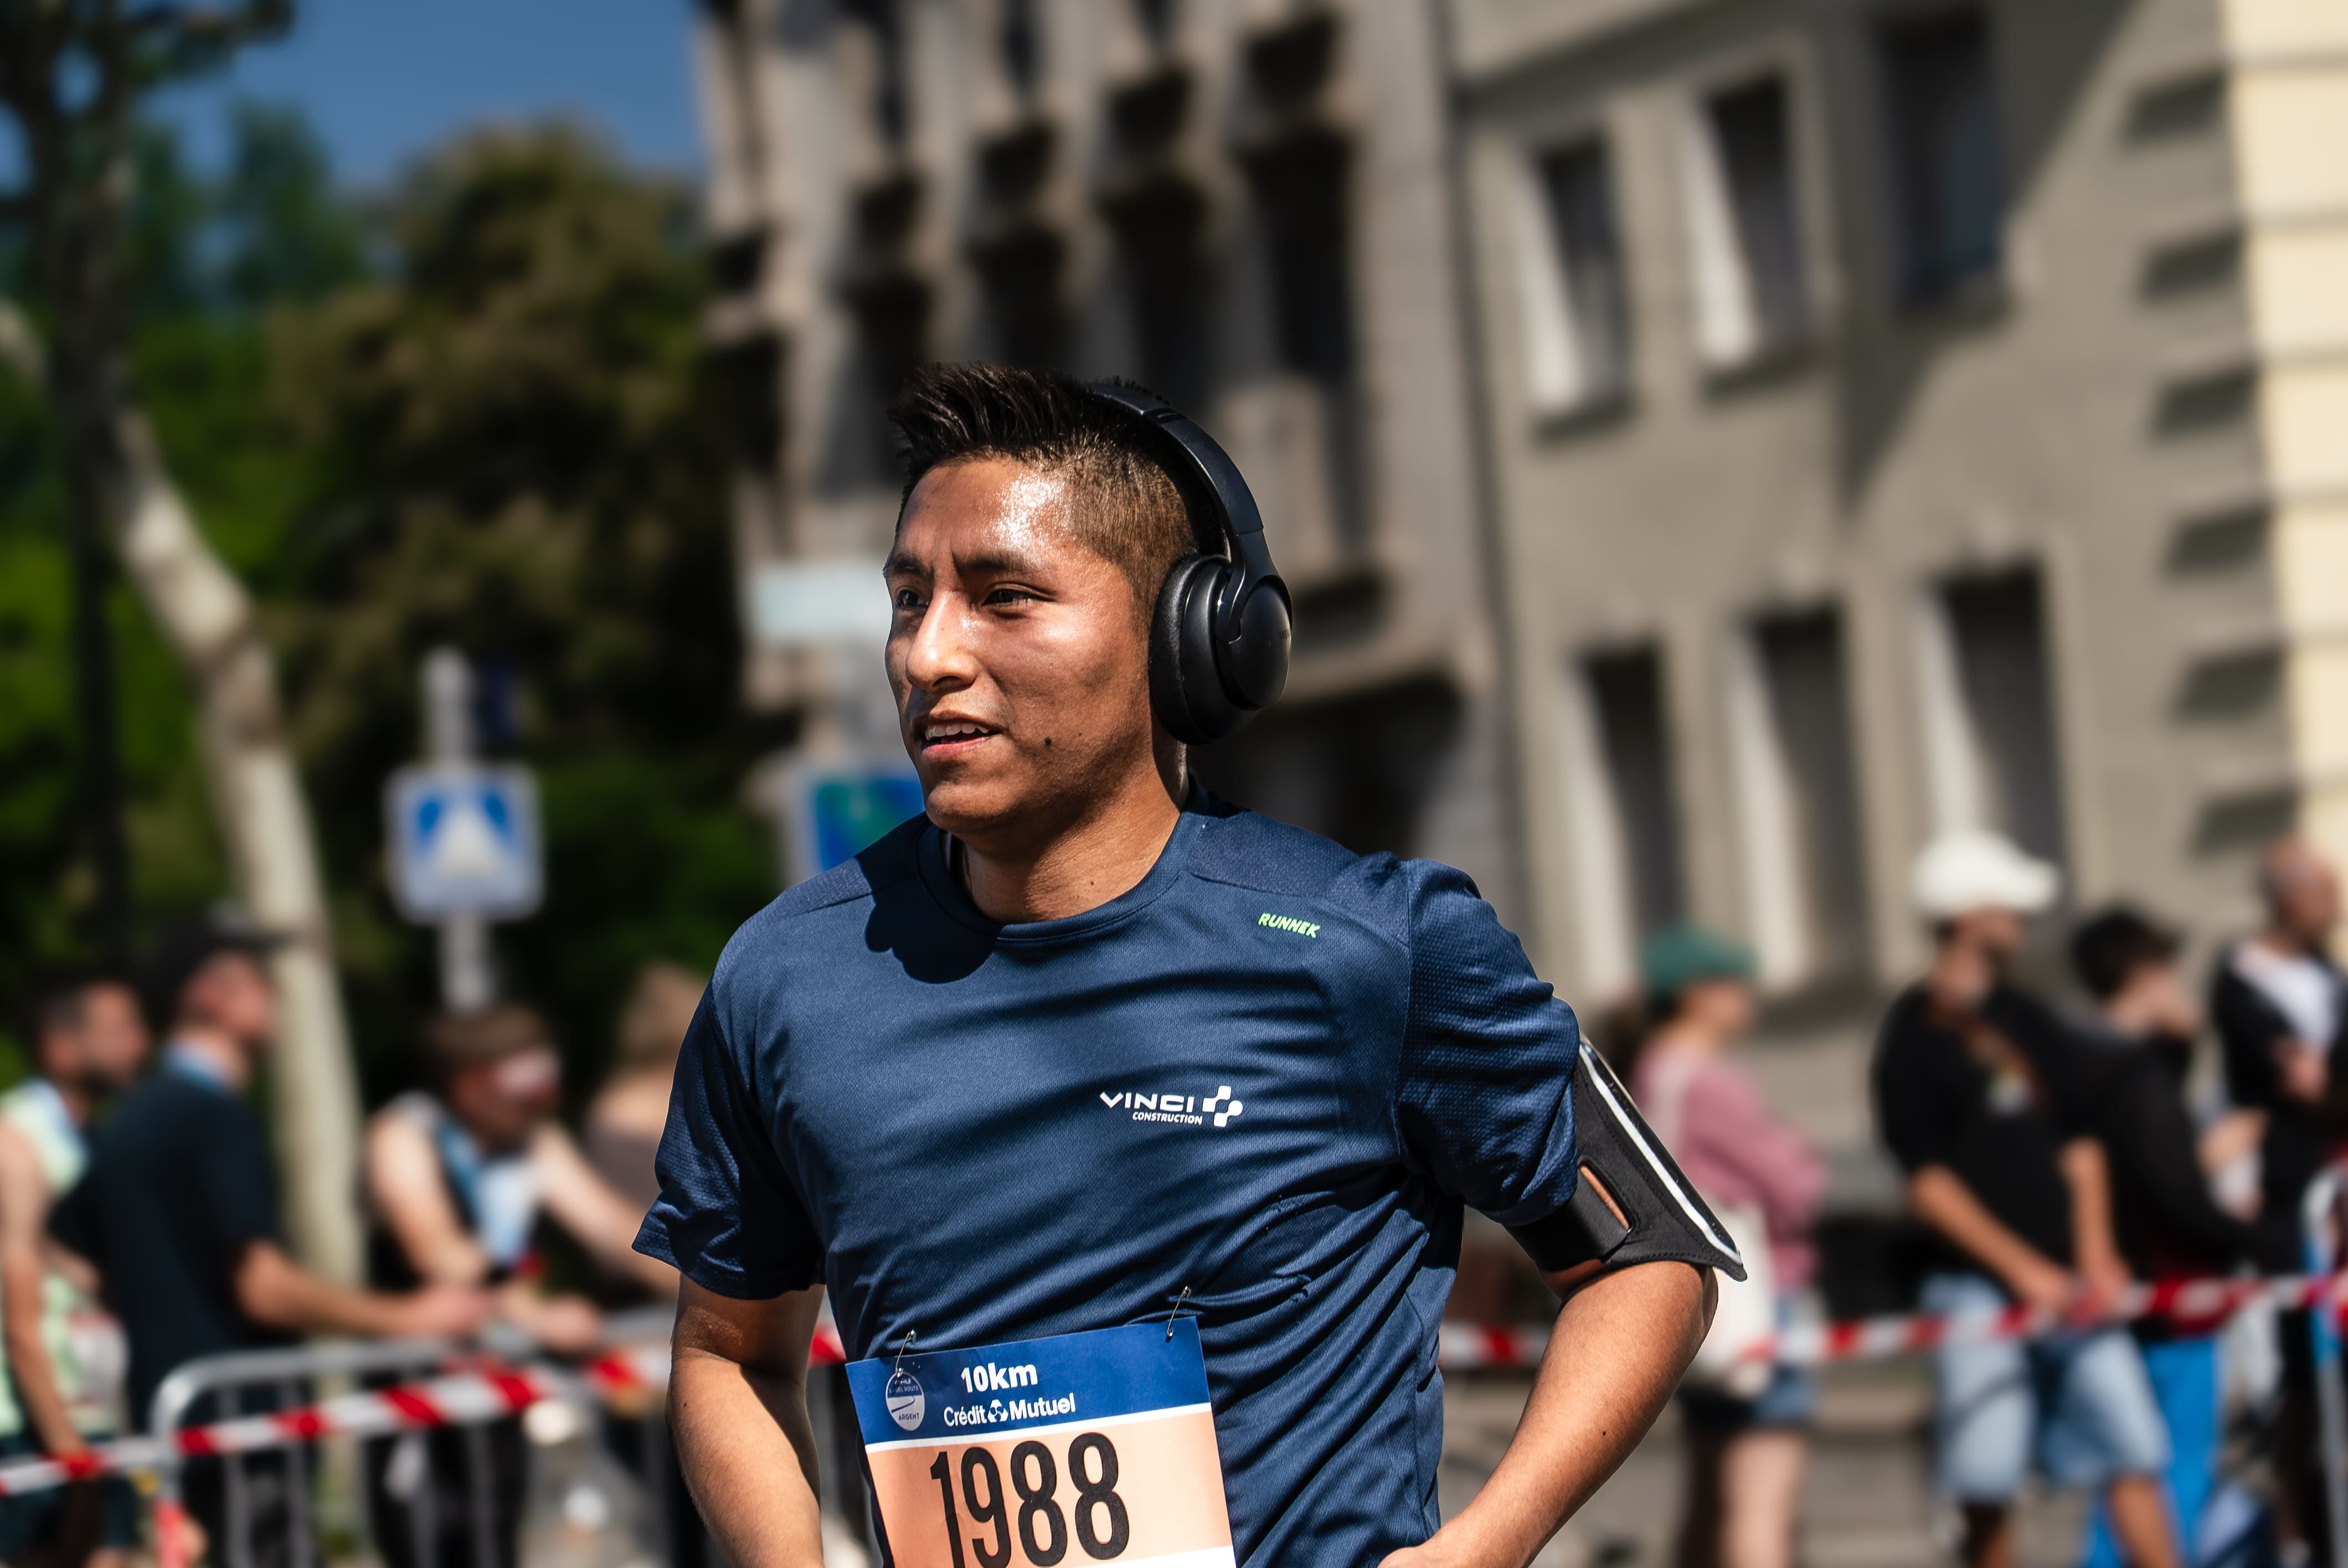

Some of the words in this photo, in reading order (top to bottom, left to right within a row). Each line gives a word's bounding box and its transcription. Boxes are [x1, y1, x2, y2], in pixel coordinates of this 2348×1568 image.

[1258, 912, 1320, 938] RUNNEK
[1100, 1092, 1194, 1113] VINCI
[1132, 1111, 1203, 1125] CONSTRUCTION
[960, 1362, 1038, 1393] 10km
[898, 1412, 920, 1421] ARGENT
[944, 1405, 987, 1427] Crédit
[1008, 1392, 1076, 1421] Mutuel
[930, 1432, 1130, 1568] 1988
